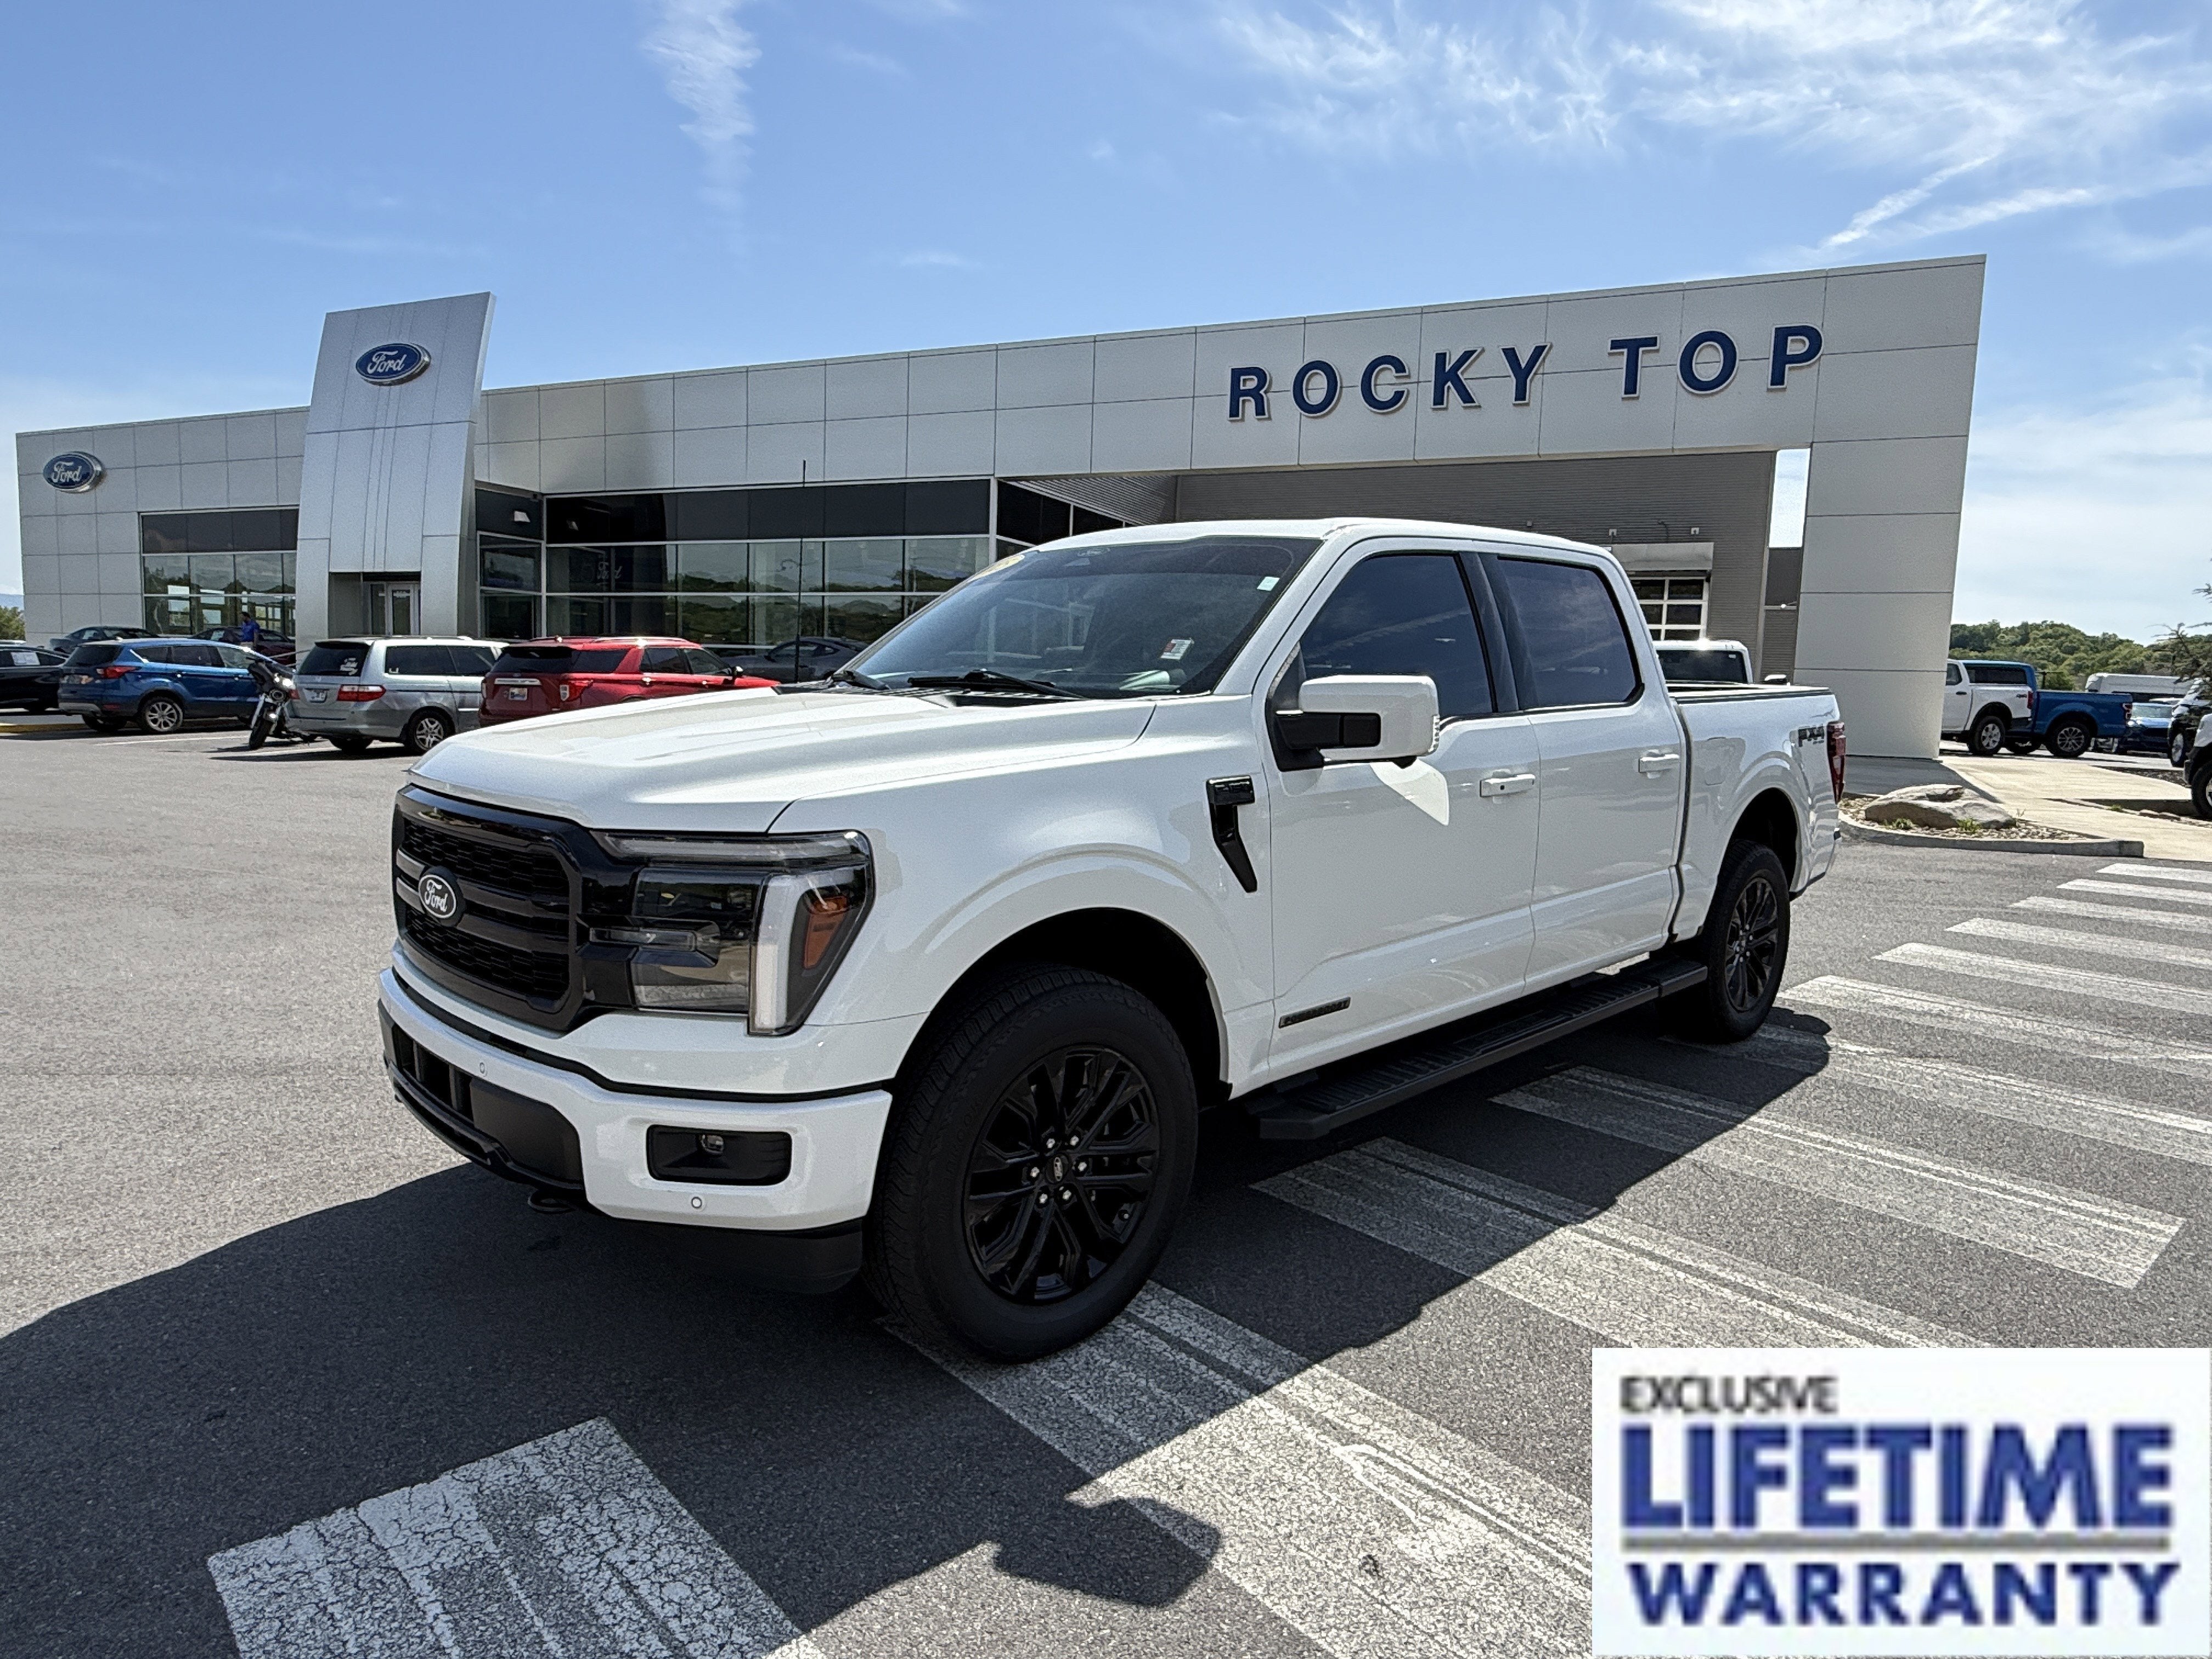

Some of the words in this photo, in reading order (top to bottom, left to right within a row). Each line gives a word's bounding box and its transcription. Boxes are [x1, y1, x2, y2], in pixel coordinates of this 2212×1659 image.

[367, 350, 407, 374] Ford
[1228, 343, 1551, 419] ROCKY
[1609, 324, 1824, 397] TOP
[50, 461, 82, 483] Ford
[424, 879, 449, 913] Ford
